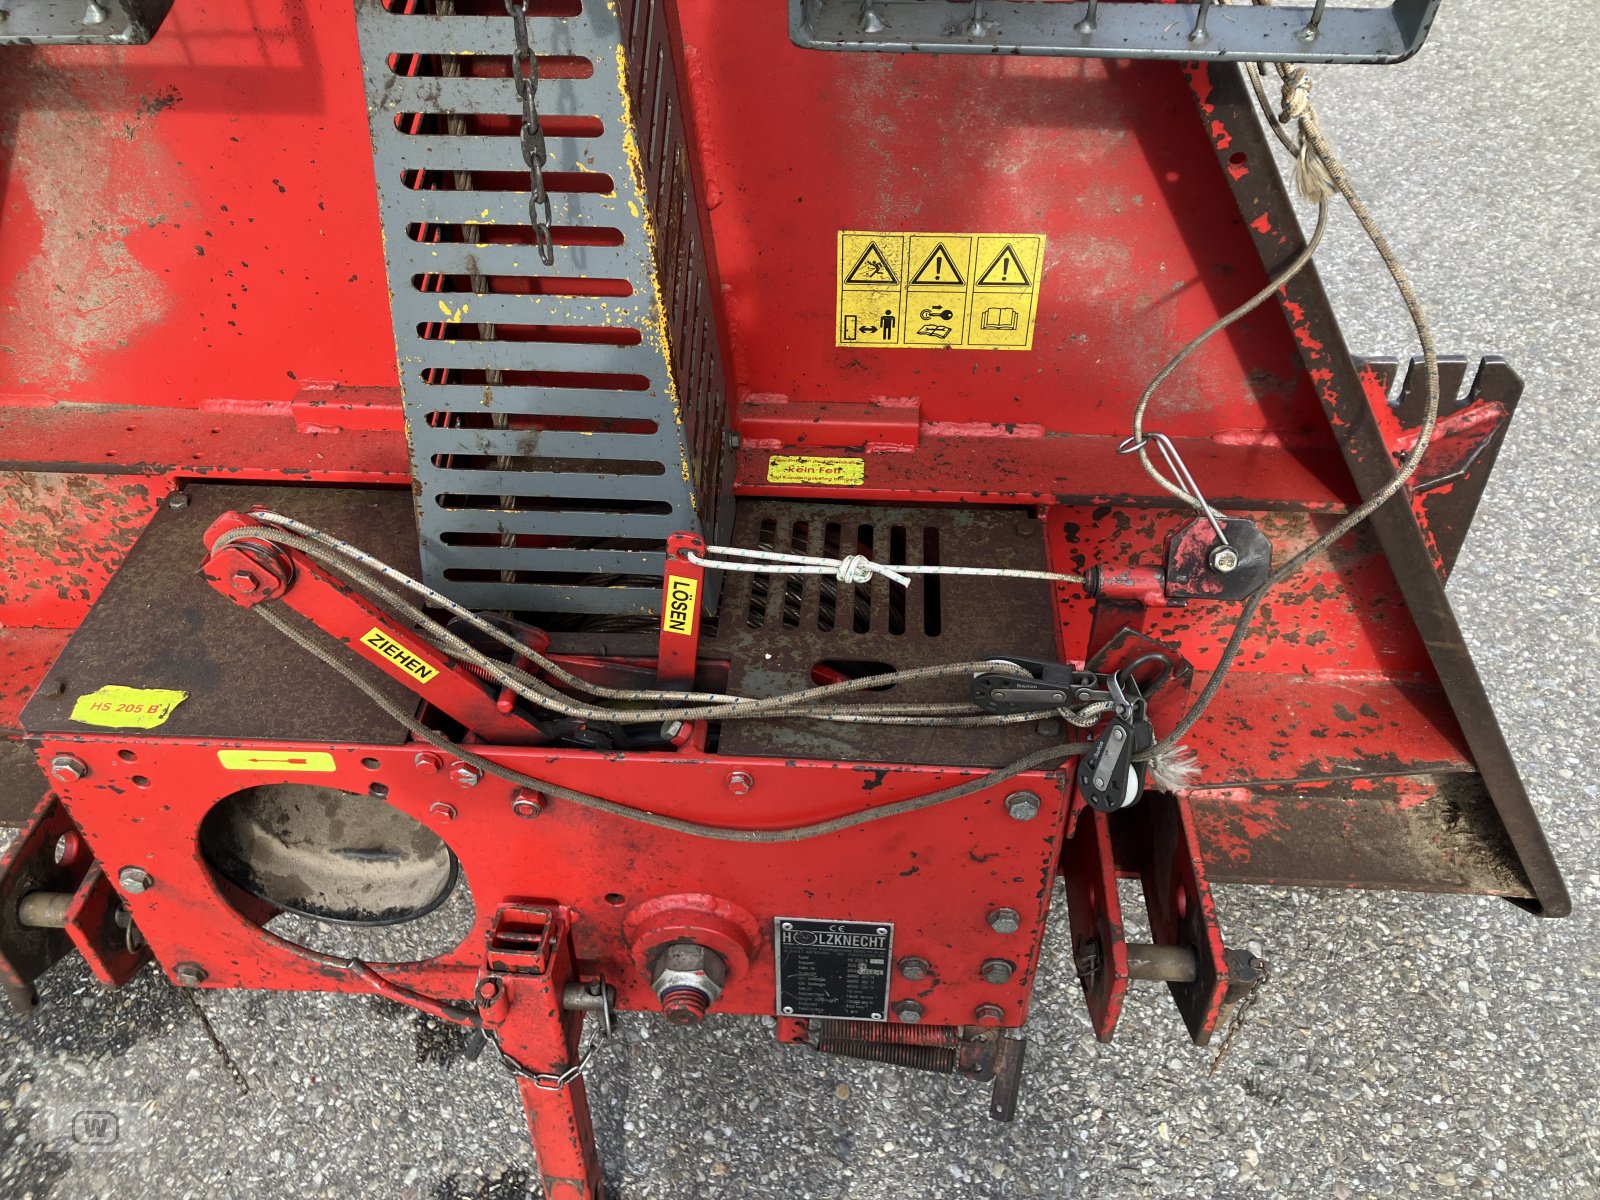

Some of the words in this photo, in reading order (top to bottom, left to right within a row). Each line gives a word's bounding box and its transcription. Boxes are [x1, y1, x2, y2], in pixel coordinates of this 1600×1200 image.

[669, 580, 692, 632] LÖSEN
[367, 633, 433, 679] ZIEHEN
[90, 702, 111, 711] HS
[116, 703, 143, 713] 205
[147, 704, 159, 714] B
[782, 931, 887, 948] HOLZKNECHT
